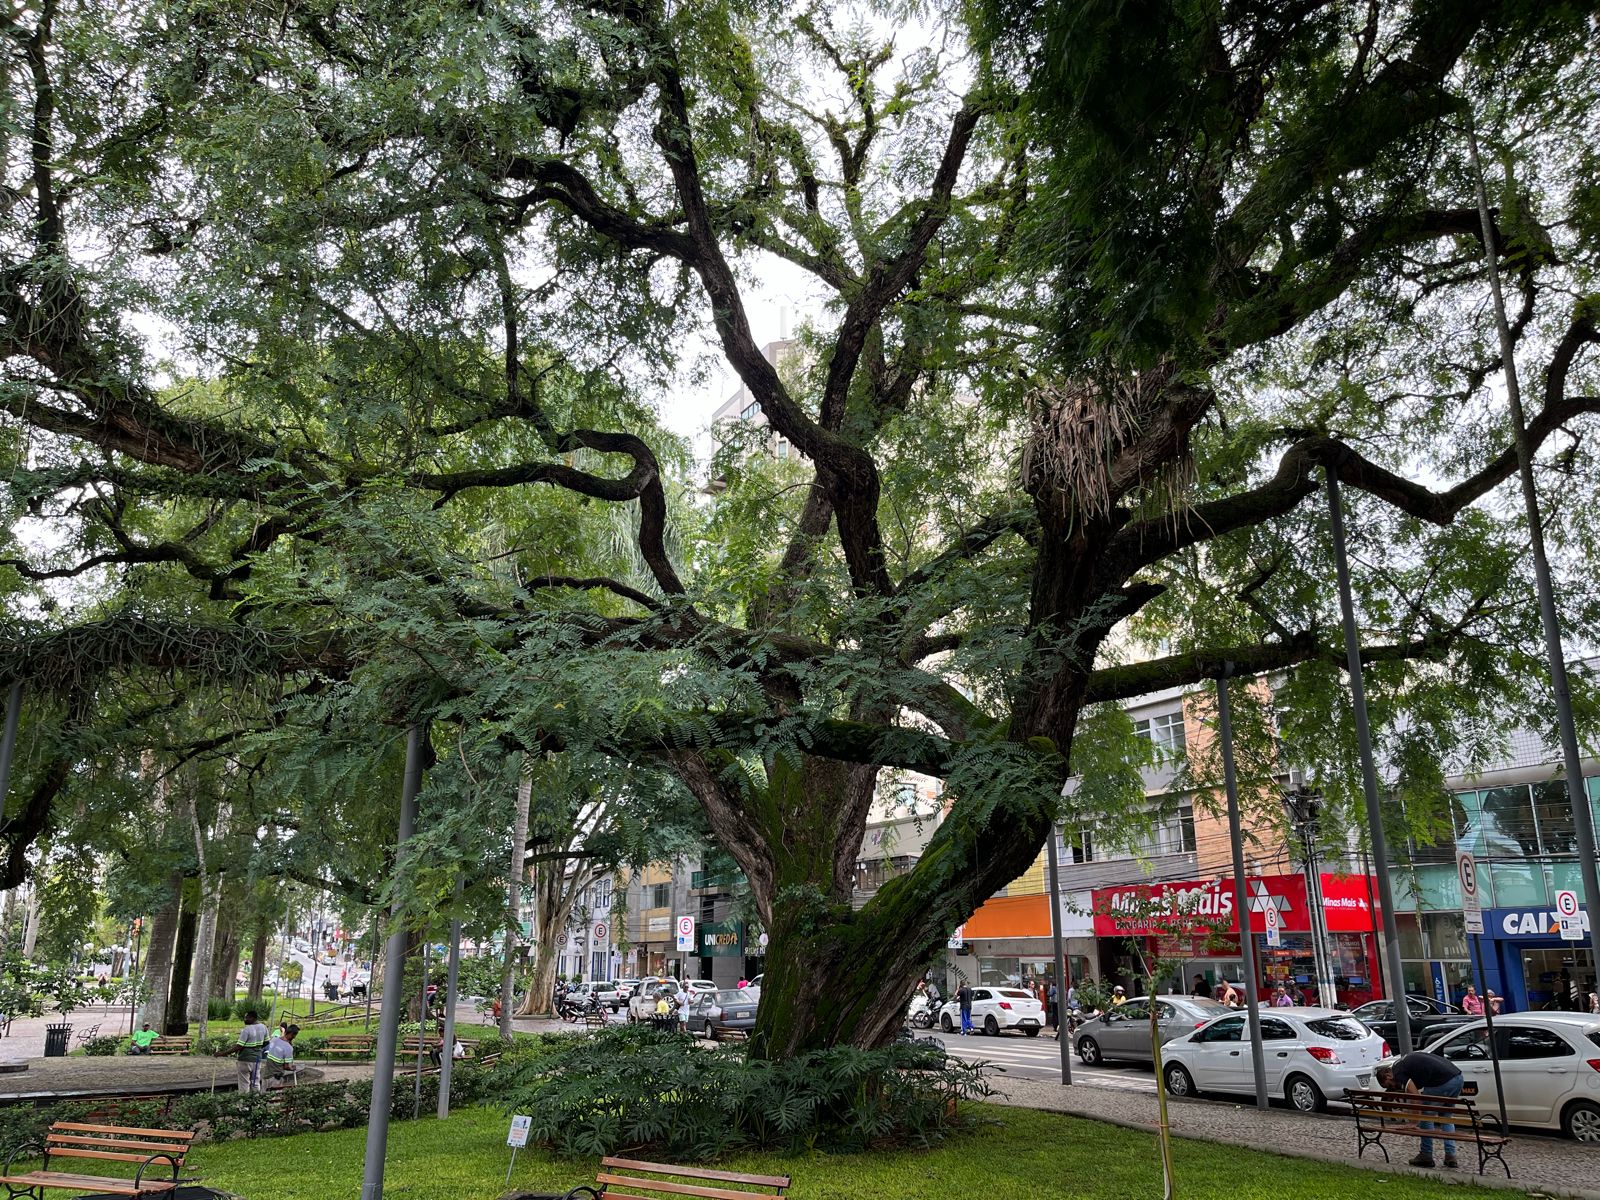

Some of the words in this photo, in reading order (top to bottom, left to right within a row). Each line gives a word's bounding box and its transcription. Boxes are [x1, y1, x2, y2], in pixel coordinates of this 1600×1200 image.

[1177, 886, 1233, 916] Mais
[1322, 897, 1341, 907] Minas
[1341, 897, 1357, 907] Mais
